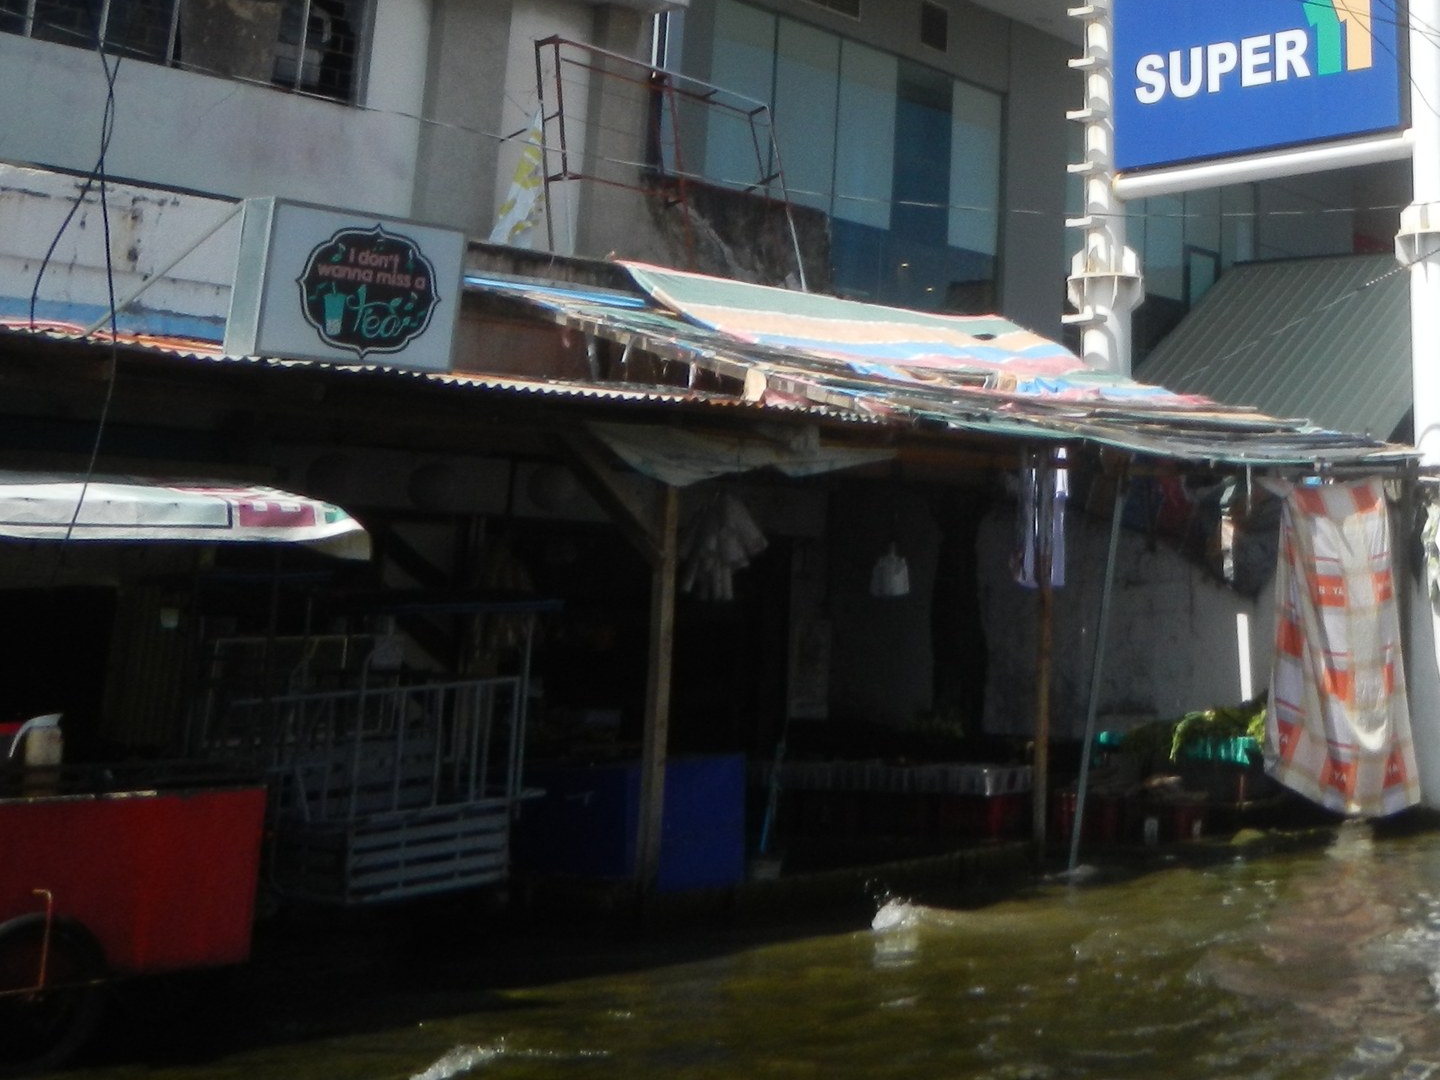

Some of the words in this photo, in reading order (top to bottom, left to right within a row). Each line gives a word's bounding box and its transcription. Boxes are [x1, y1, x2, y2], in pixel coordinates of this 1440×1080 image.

[349, 248, 356, 262] I
[358, 250, 400, 269] don't
[317, 264, 373, 282] wanna
[376, 270, 411, 288] miss
[414, 276, 426, 290] a
